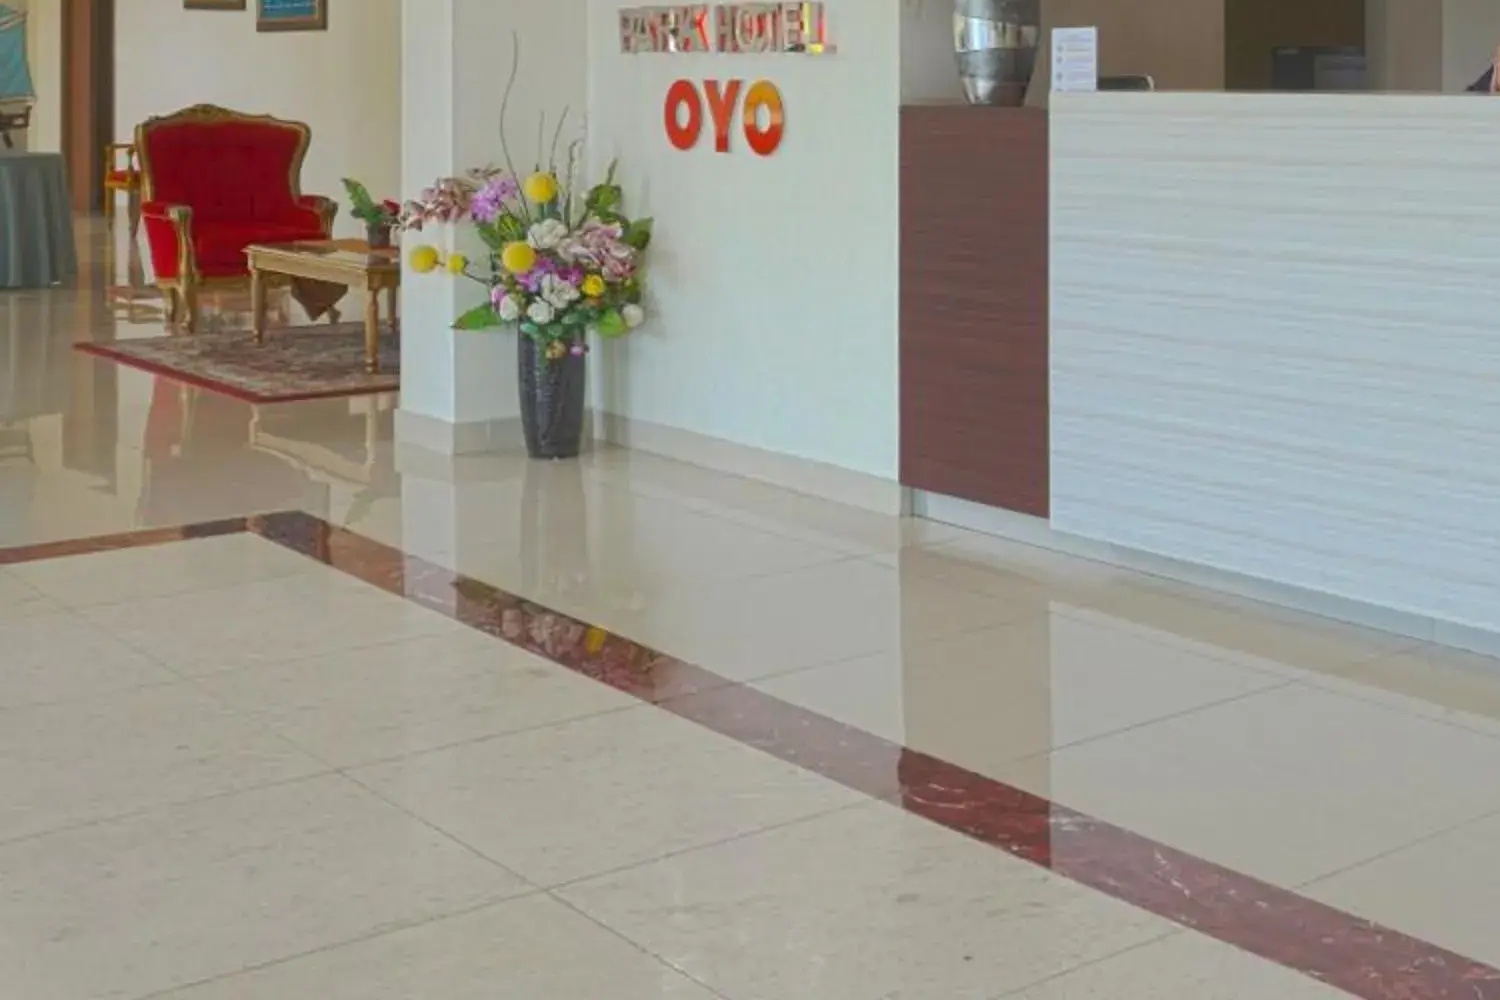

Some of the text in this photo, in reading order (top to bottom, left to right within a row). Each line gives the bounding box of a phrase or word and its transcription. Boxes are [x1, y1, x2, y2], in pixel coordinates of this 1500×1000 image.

[618, 0, 838, 55] PARK HOTEL
[663, 78, 785, 157] OYO
